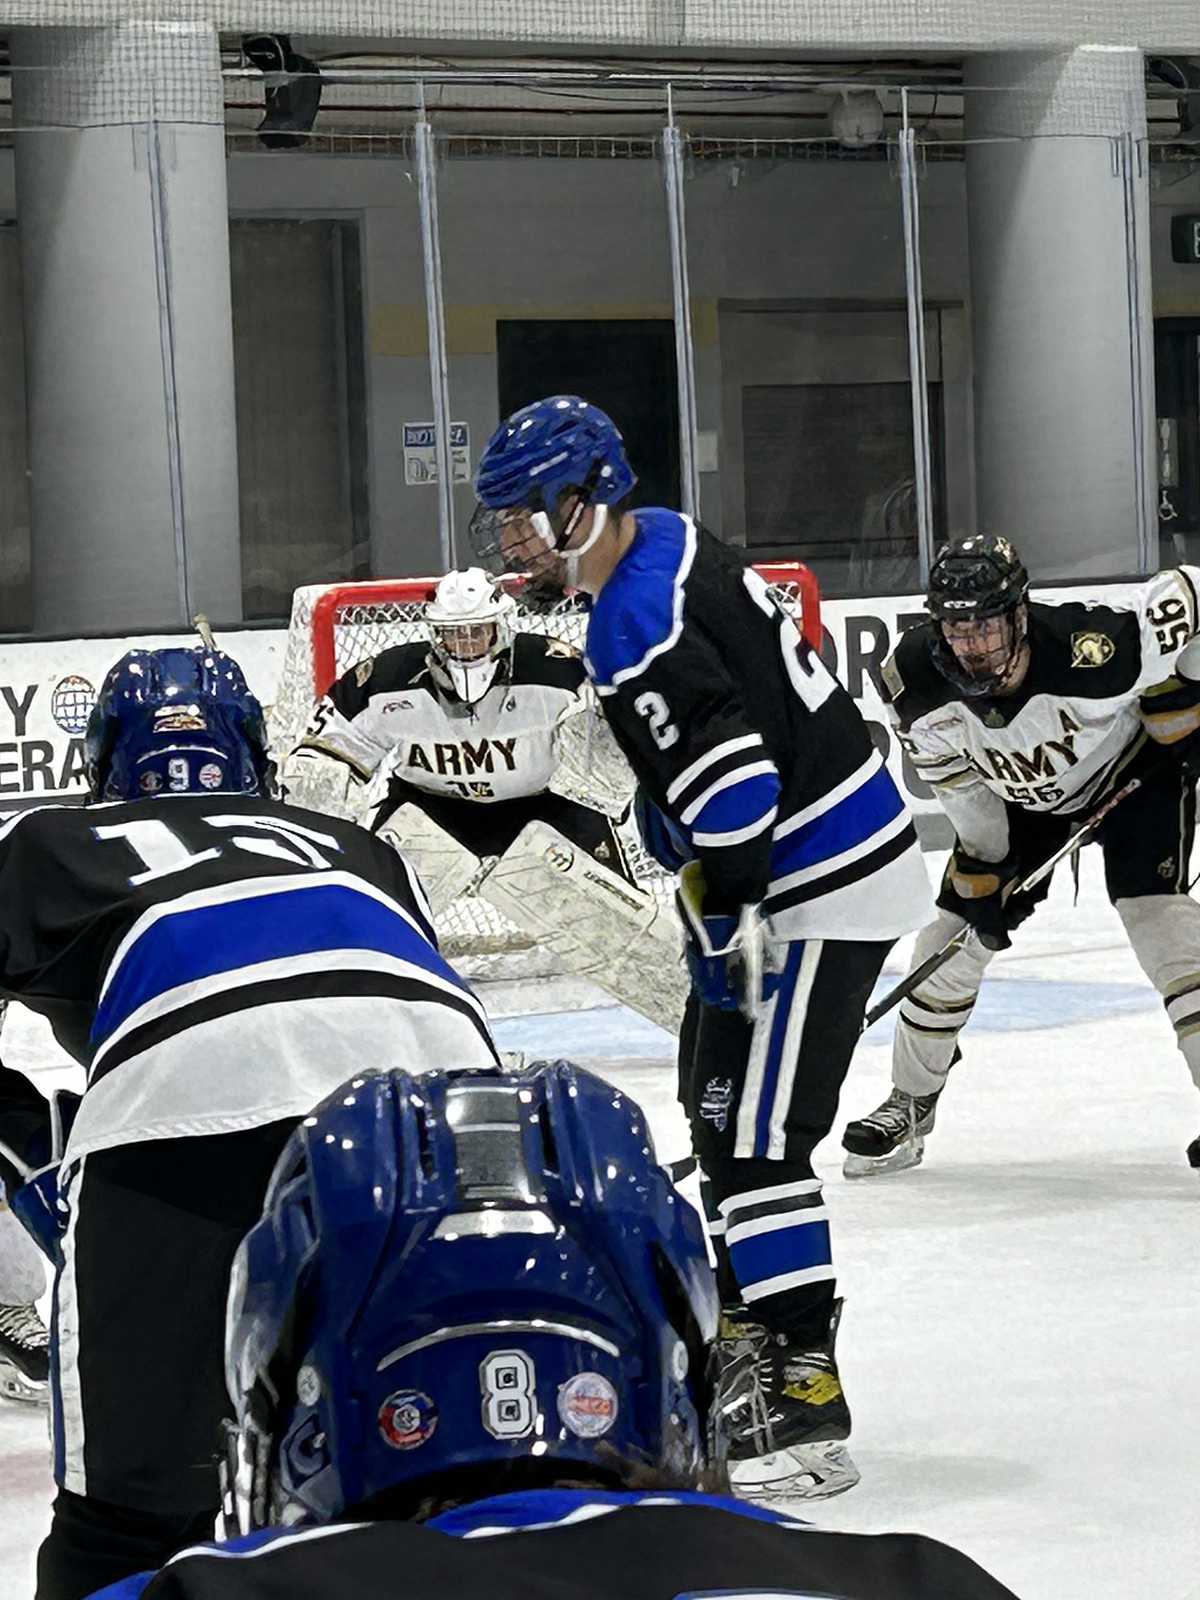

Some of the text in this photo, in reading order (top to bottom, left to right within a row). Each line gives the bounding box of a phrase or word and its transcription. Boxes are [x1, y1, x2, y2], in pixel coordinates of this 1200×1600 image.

[634, 691, 680, 751] 2
[168, 758, 189, 791] 9
[408, 738, 517, 776] ARMY
[479, 1349, 537, 1440] 8
